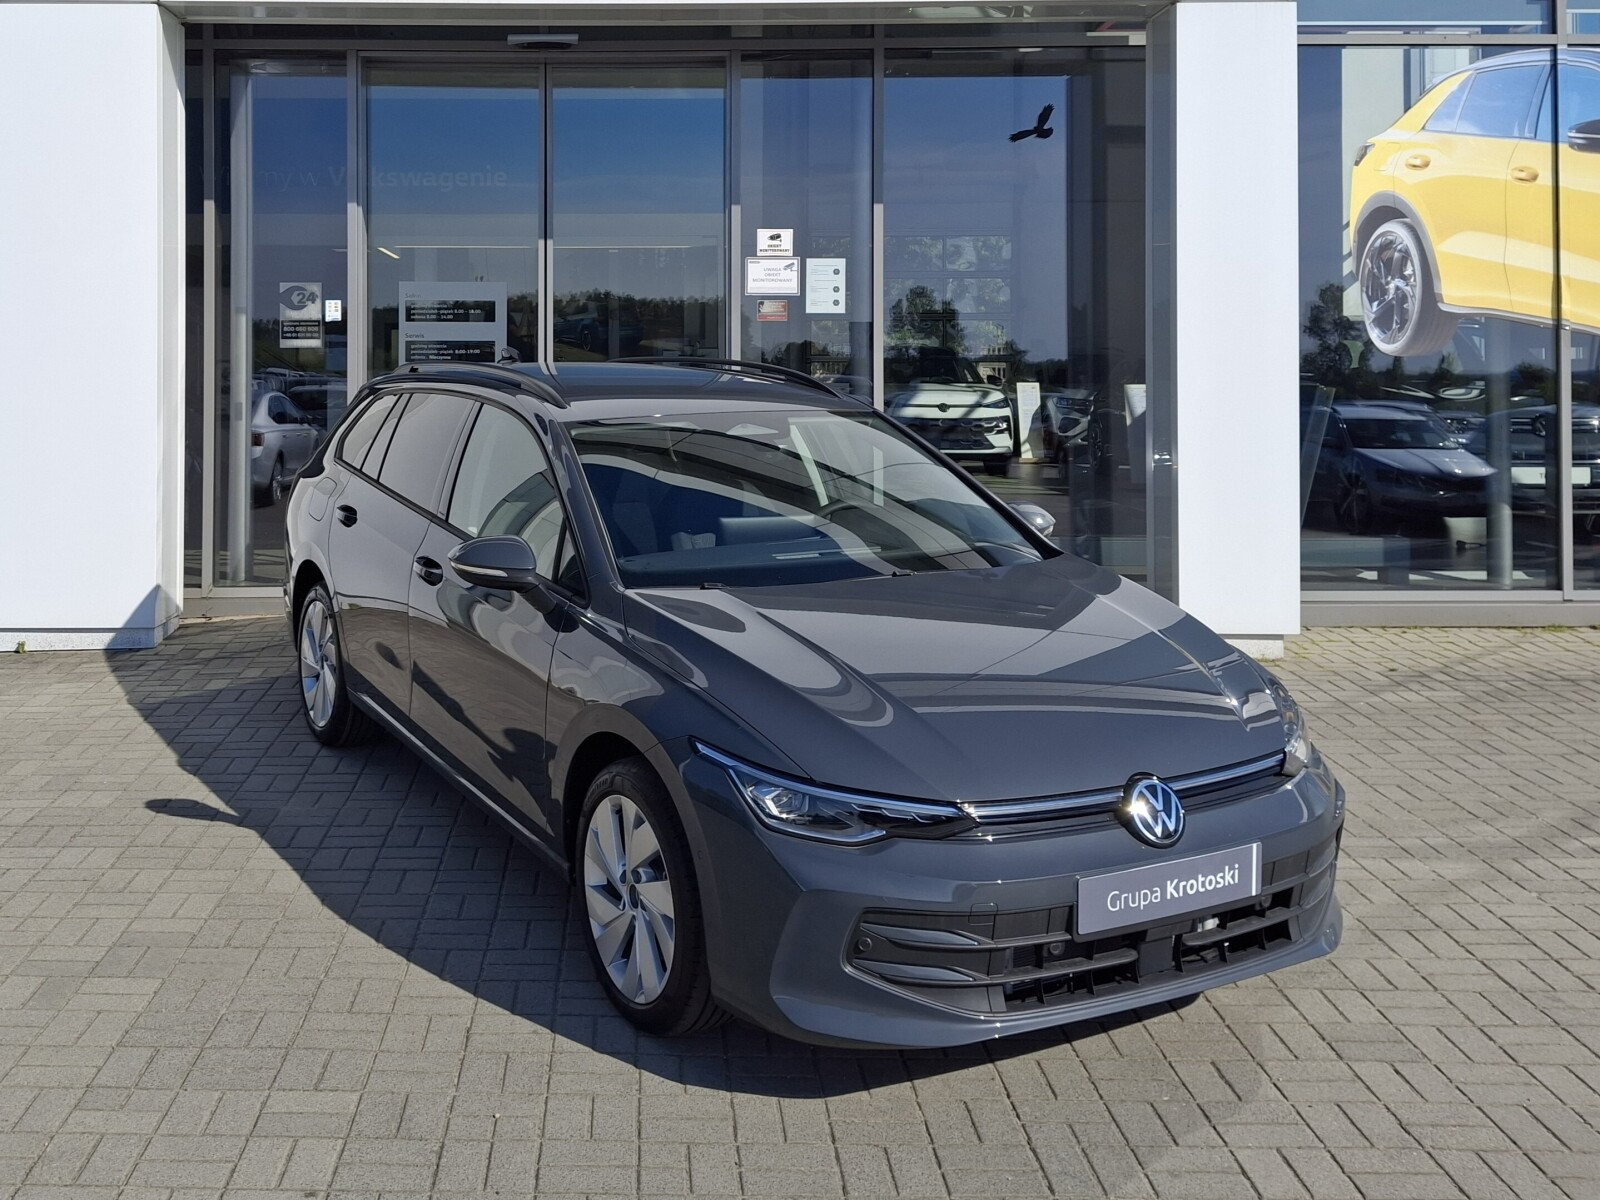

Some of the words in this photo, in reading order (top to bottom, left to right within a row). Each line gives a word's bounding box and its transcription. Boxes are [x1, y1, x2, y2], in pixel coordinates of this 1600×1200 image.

[328, 165, 508, 192] Vkswagenie
[1106, 886, 1161, 912] Grupa
[1166, 864, 1239, 900] Krotoski
